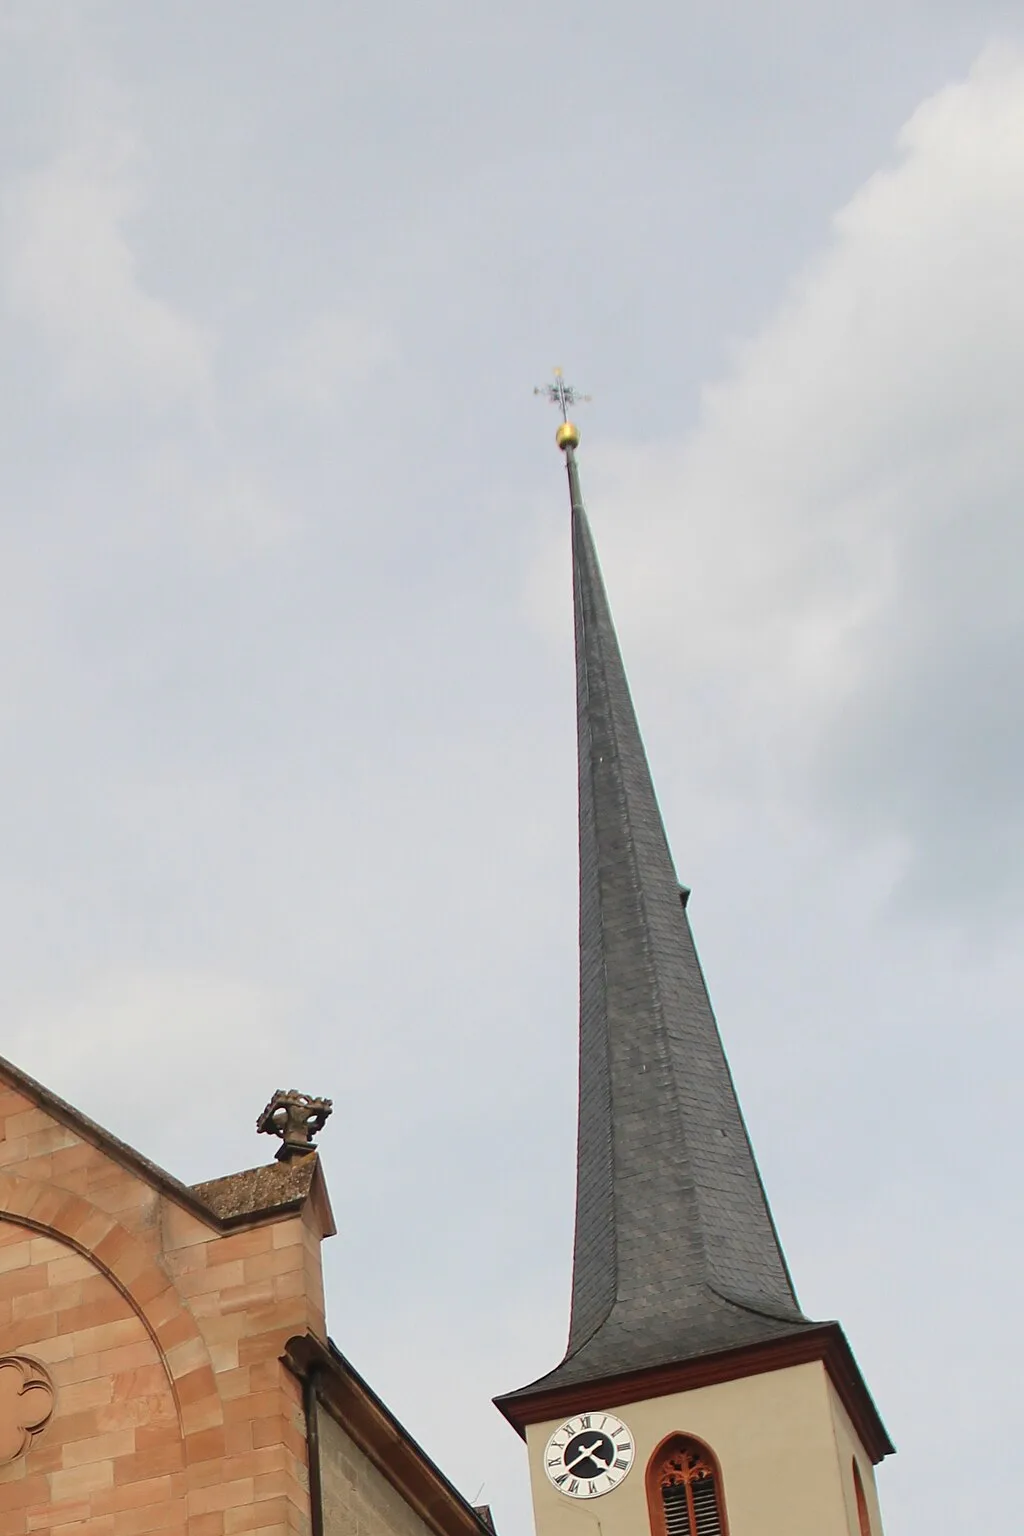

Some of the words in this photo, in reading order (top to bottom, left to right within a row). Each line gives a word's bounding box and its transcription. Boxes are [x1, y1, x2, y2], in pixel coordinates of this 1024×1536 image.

[580, 1416, 591, 1429] XII
[600, 1417, 607, 1429] I
[563, 1425, 575, 1438] XI
[611, 1426, 624, 1438] II
[551, 1440, 564, 1449] X
[617, 1442, 631, 1451] III
[548, 1457, 561, 1467] IX
[606, 1475, 616, 1485] V
[568, 1479, 580, 1494] VII
[588, 1481, 597, 1494] VI
